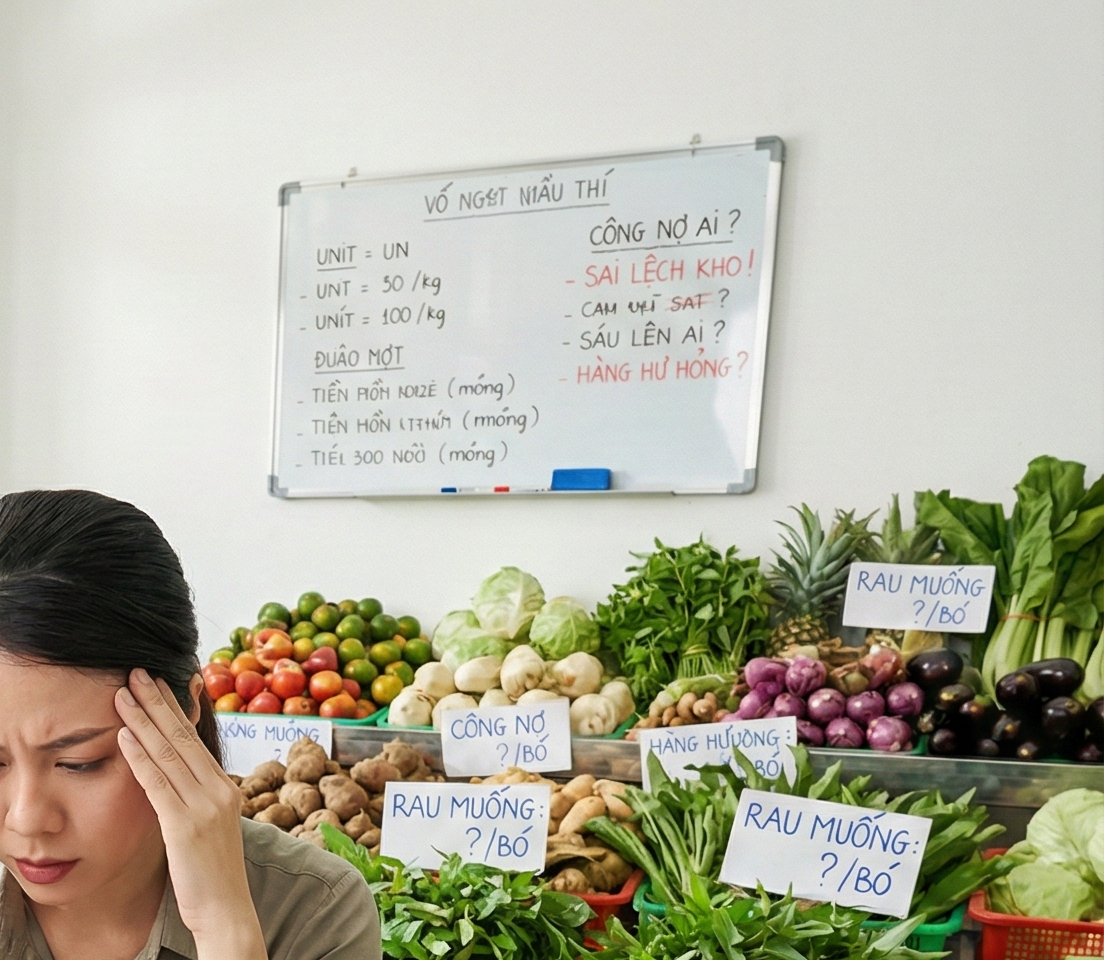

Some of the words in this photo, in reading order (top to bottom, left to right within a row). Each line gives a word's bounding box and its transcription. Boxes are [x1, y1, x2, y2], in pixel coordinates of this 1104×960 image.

[590, 217, 645, 246] CÔNG
[657, 213, 688, 244] NỢ
[631, 254, 685, 289] LỆCH
[632, 321, 671, 346] LÊN
[577, 355, 632, 384] HÀNG
[641, 356, 669, 381] HƯ
[857, 570, 902, 594] RAU
[909, 566, 986, 597] MUỐNG
[450, 713, 506, 740] CÔNG
[515, 709, 546, 738] NỢ
[649, 730, 699, 755] HÀNG
[392, 793, 442, 819] RAU
[744, 802, 803, 835] RAU
